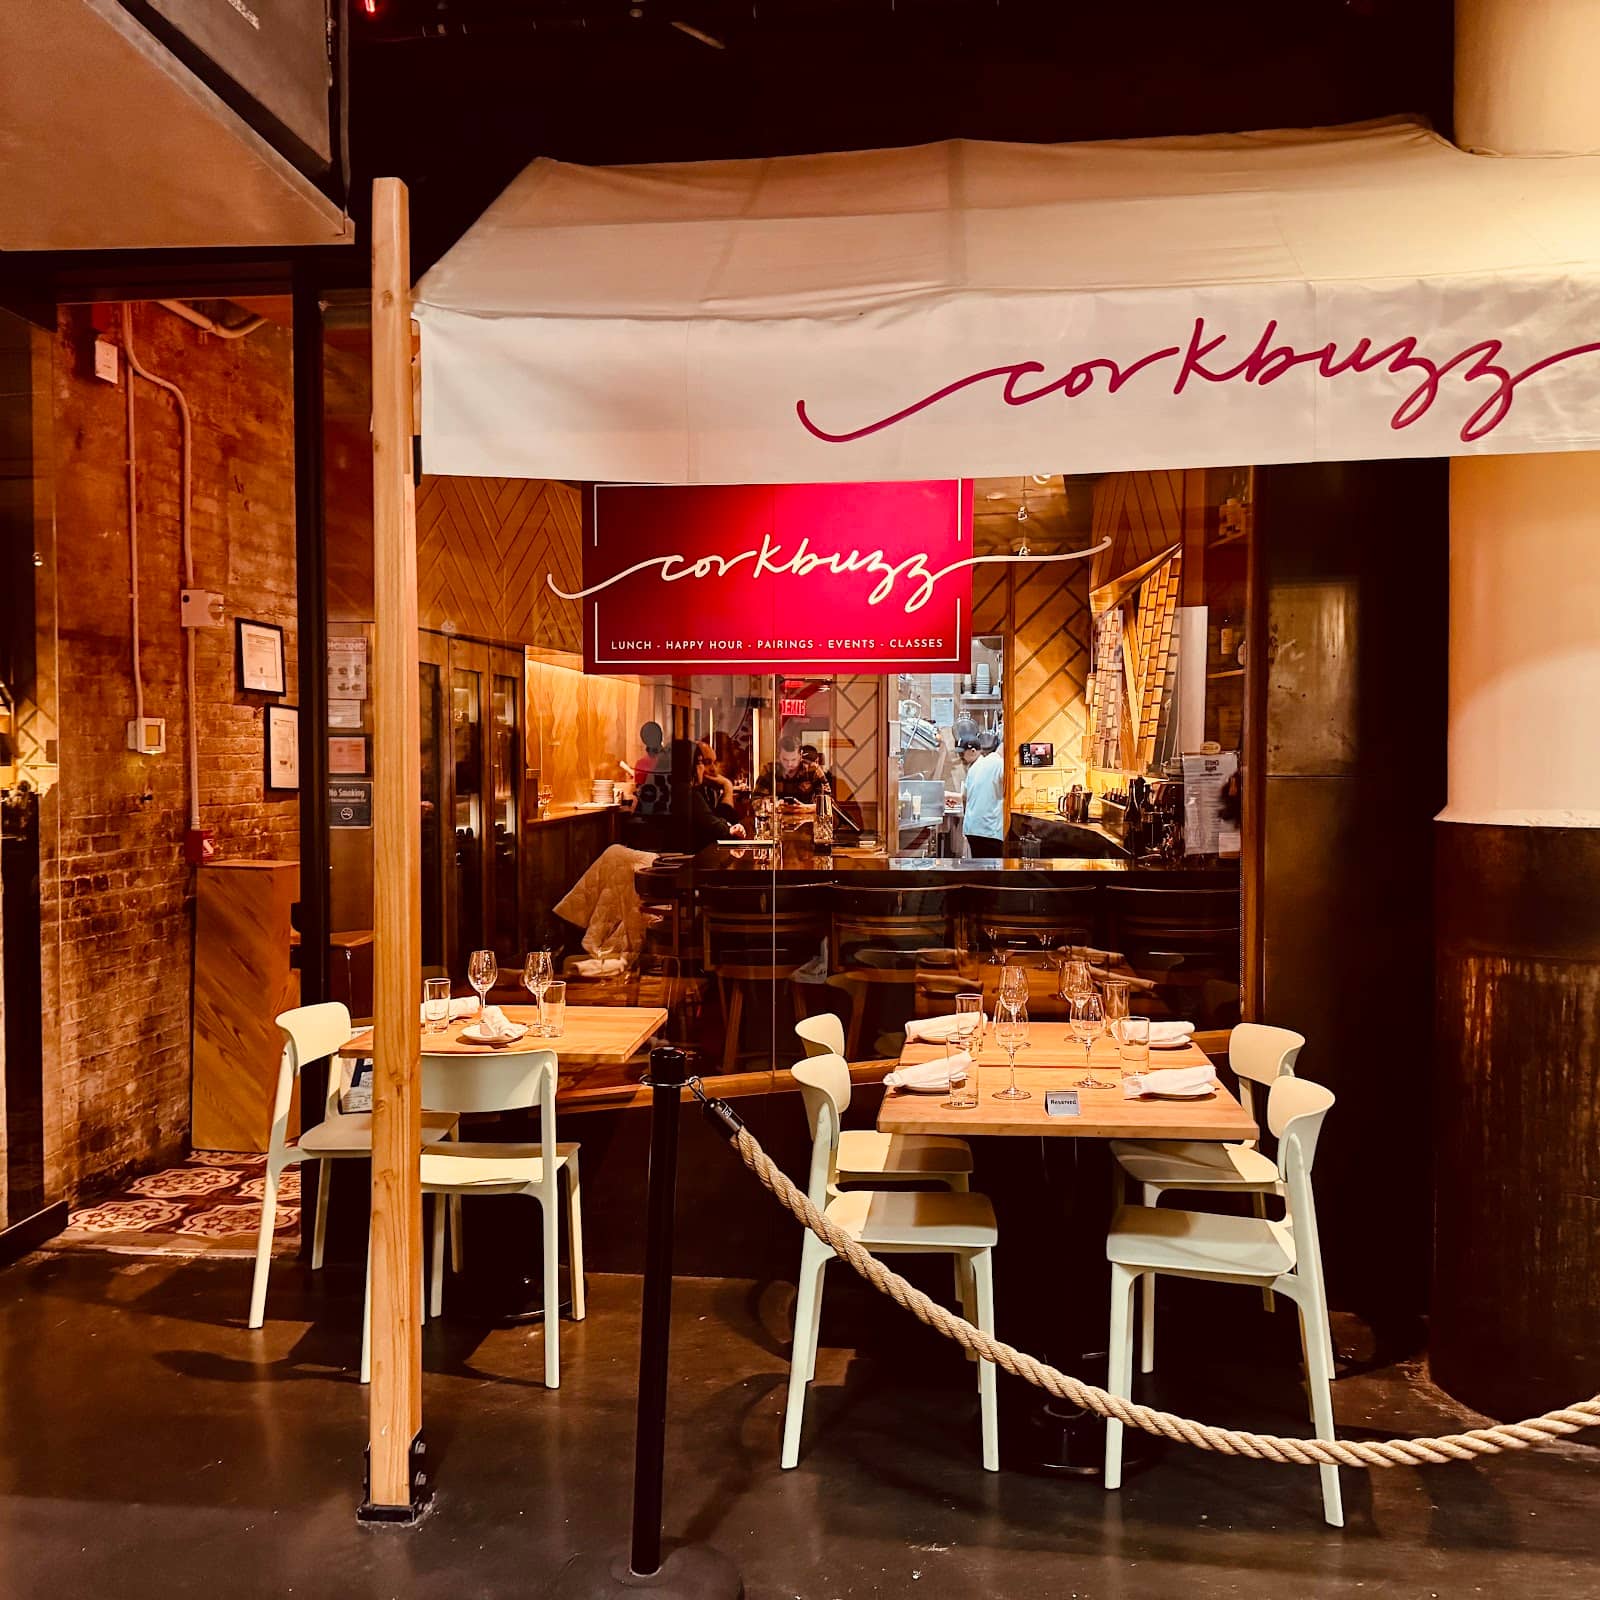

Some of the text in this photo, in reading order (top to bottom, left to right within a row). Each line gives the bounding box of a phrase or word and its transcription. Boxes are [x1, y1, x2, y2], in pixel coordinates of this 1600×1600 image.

[796, 317, 1600, 443] corkbuzz
[547, 533, 1112, 613] corkbuzz
[611, 638, 943, 650] LUNCH HAPPY HOUR PAIRINGS EVENTS CLASSES
